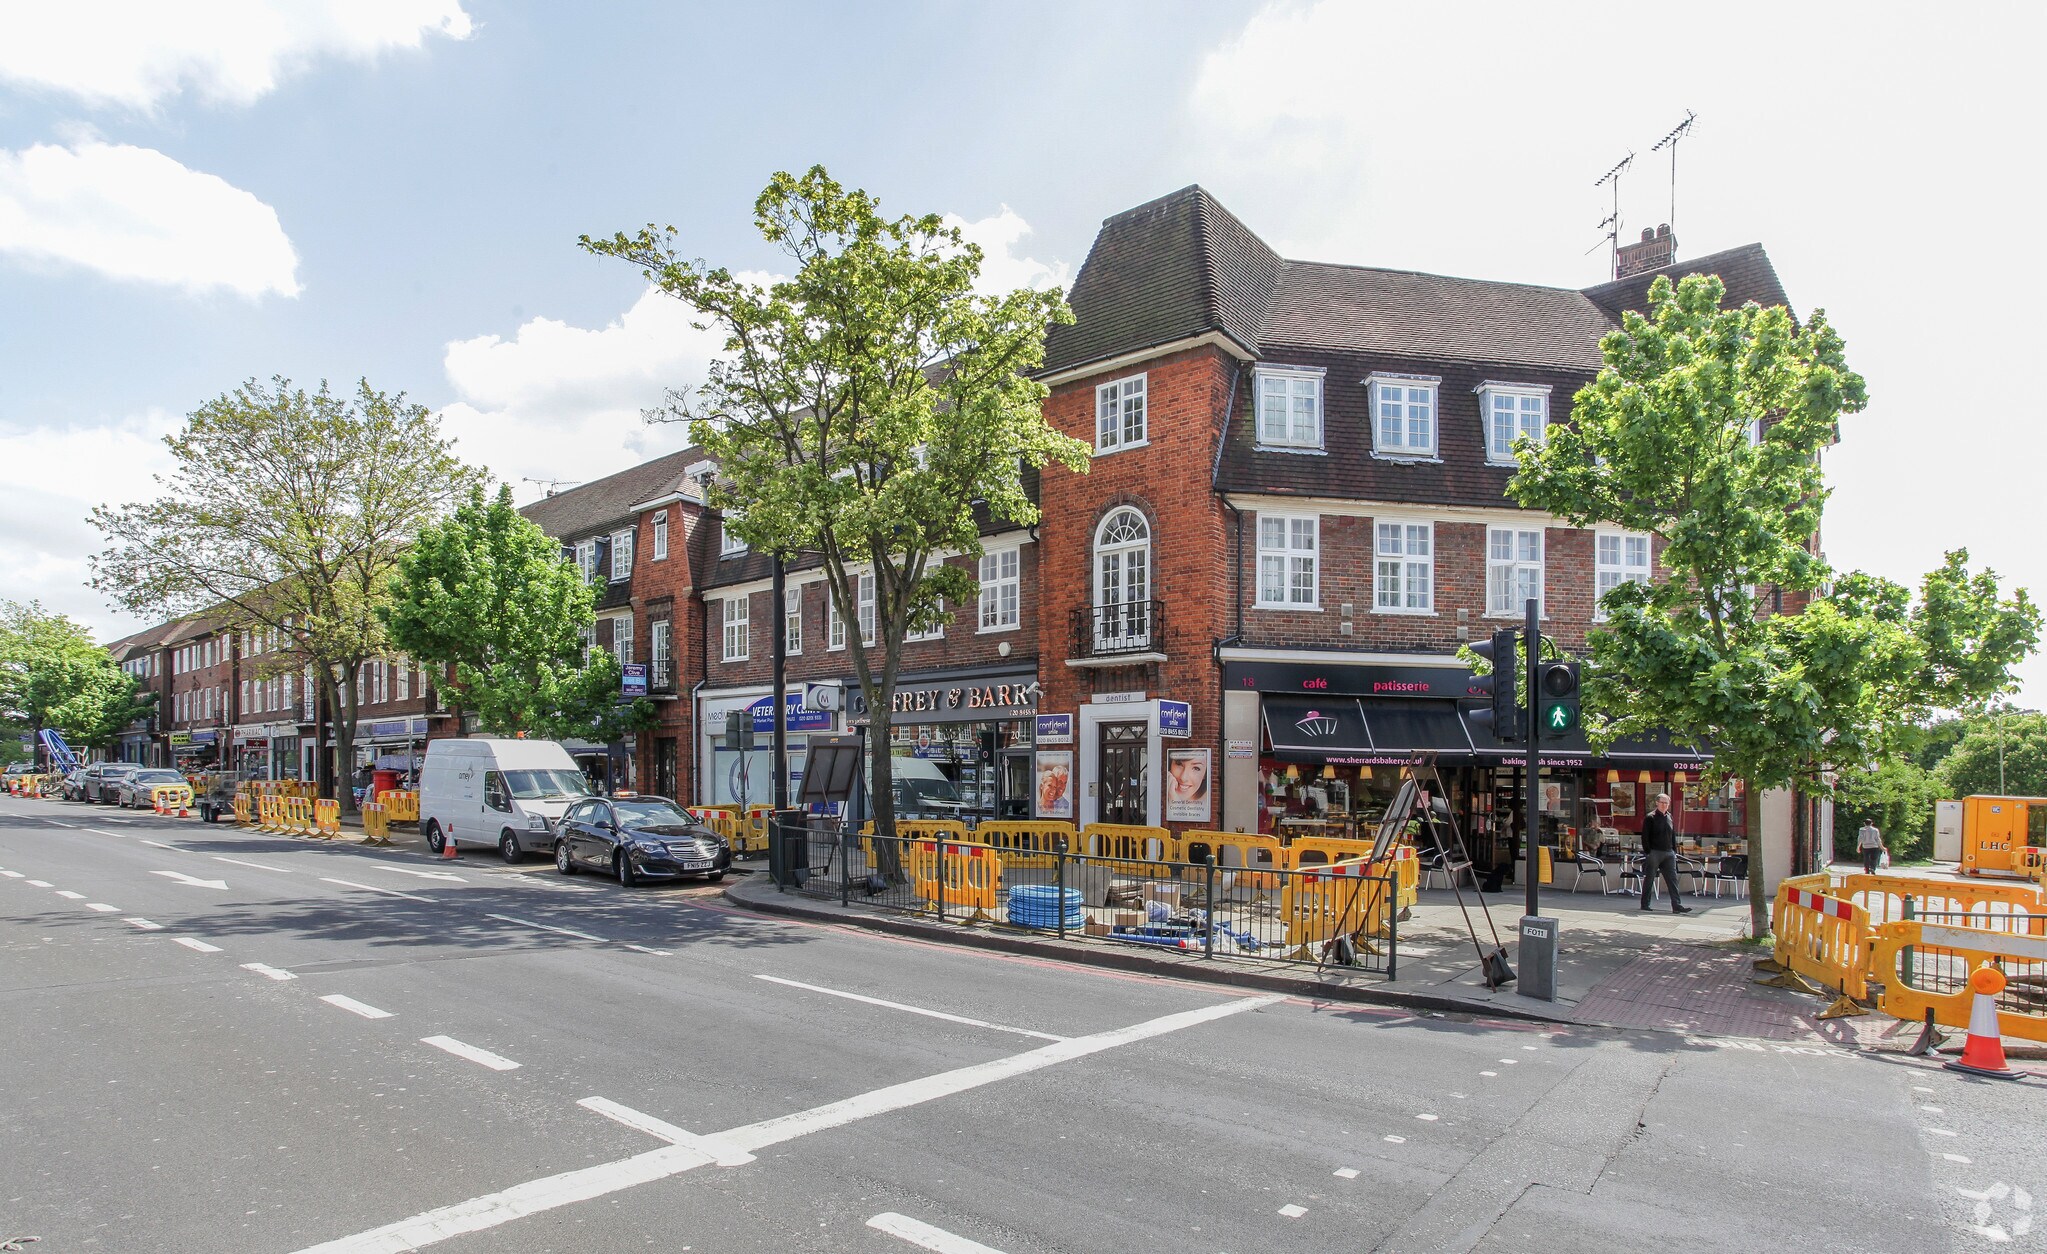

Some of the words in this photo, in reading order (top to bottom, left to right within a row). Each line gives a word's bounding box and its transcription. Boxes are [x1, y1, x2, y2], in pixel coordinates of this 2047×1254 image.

[1242, 677, 1254, 687] 18
[1303, 677, 1327, 689] café
[1373, 680, 1430, 692] patisserie
[853, 690, 939, 714] GFREY
[946, 688, 961, 709] &
[968, 683, 1029, 709] BARR
[1105, 694, 1131, 702] dentist
[752, 703, 796, 716] VETERRY
[1011, 731, 1020, 740] 20
[1159, 727, 1167, 735] 020
[1326, 756, 1422, 766] www.sherrardsbakery.c.u
[1502, 757, 1527, 766] baking
[1980, 841, 2010, 851] LHC
